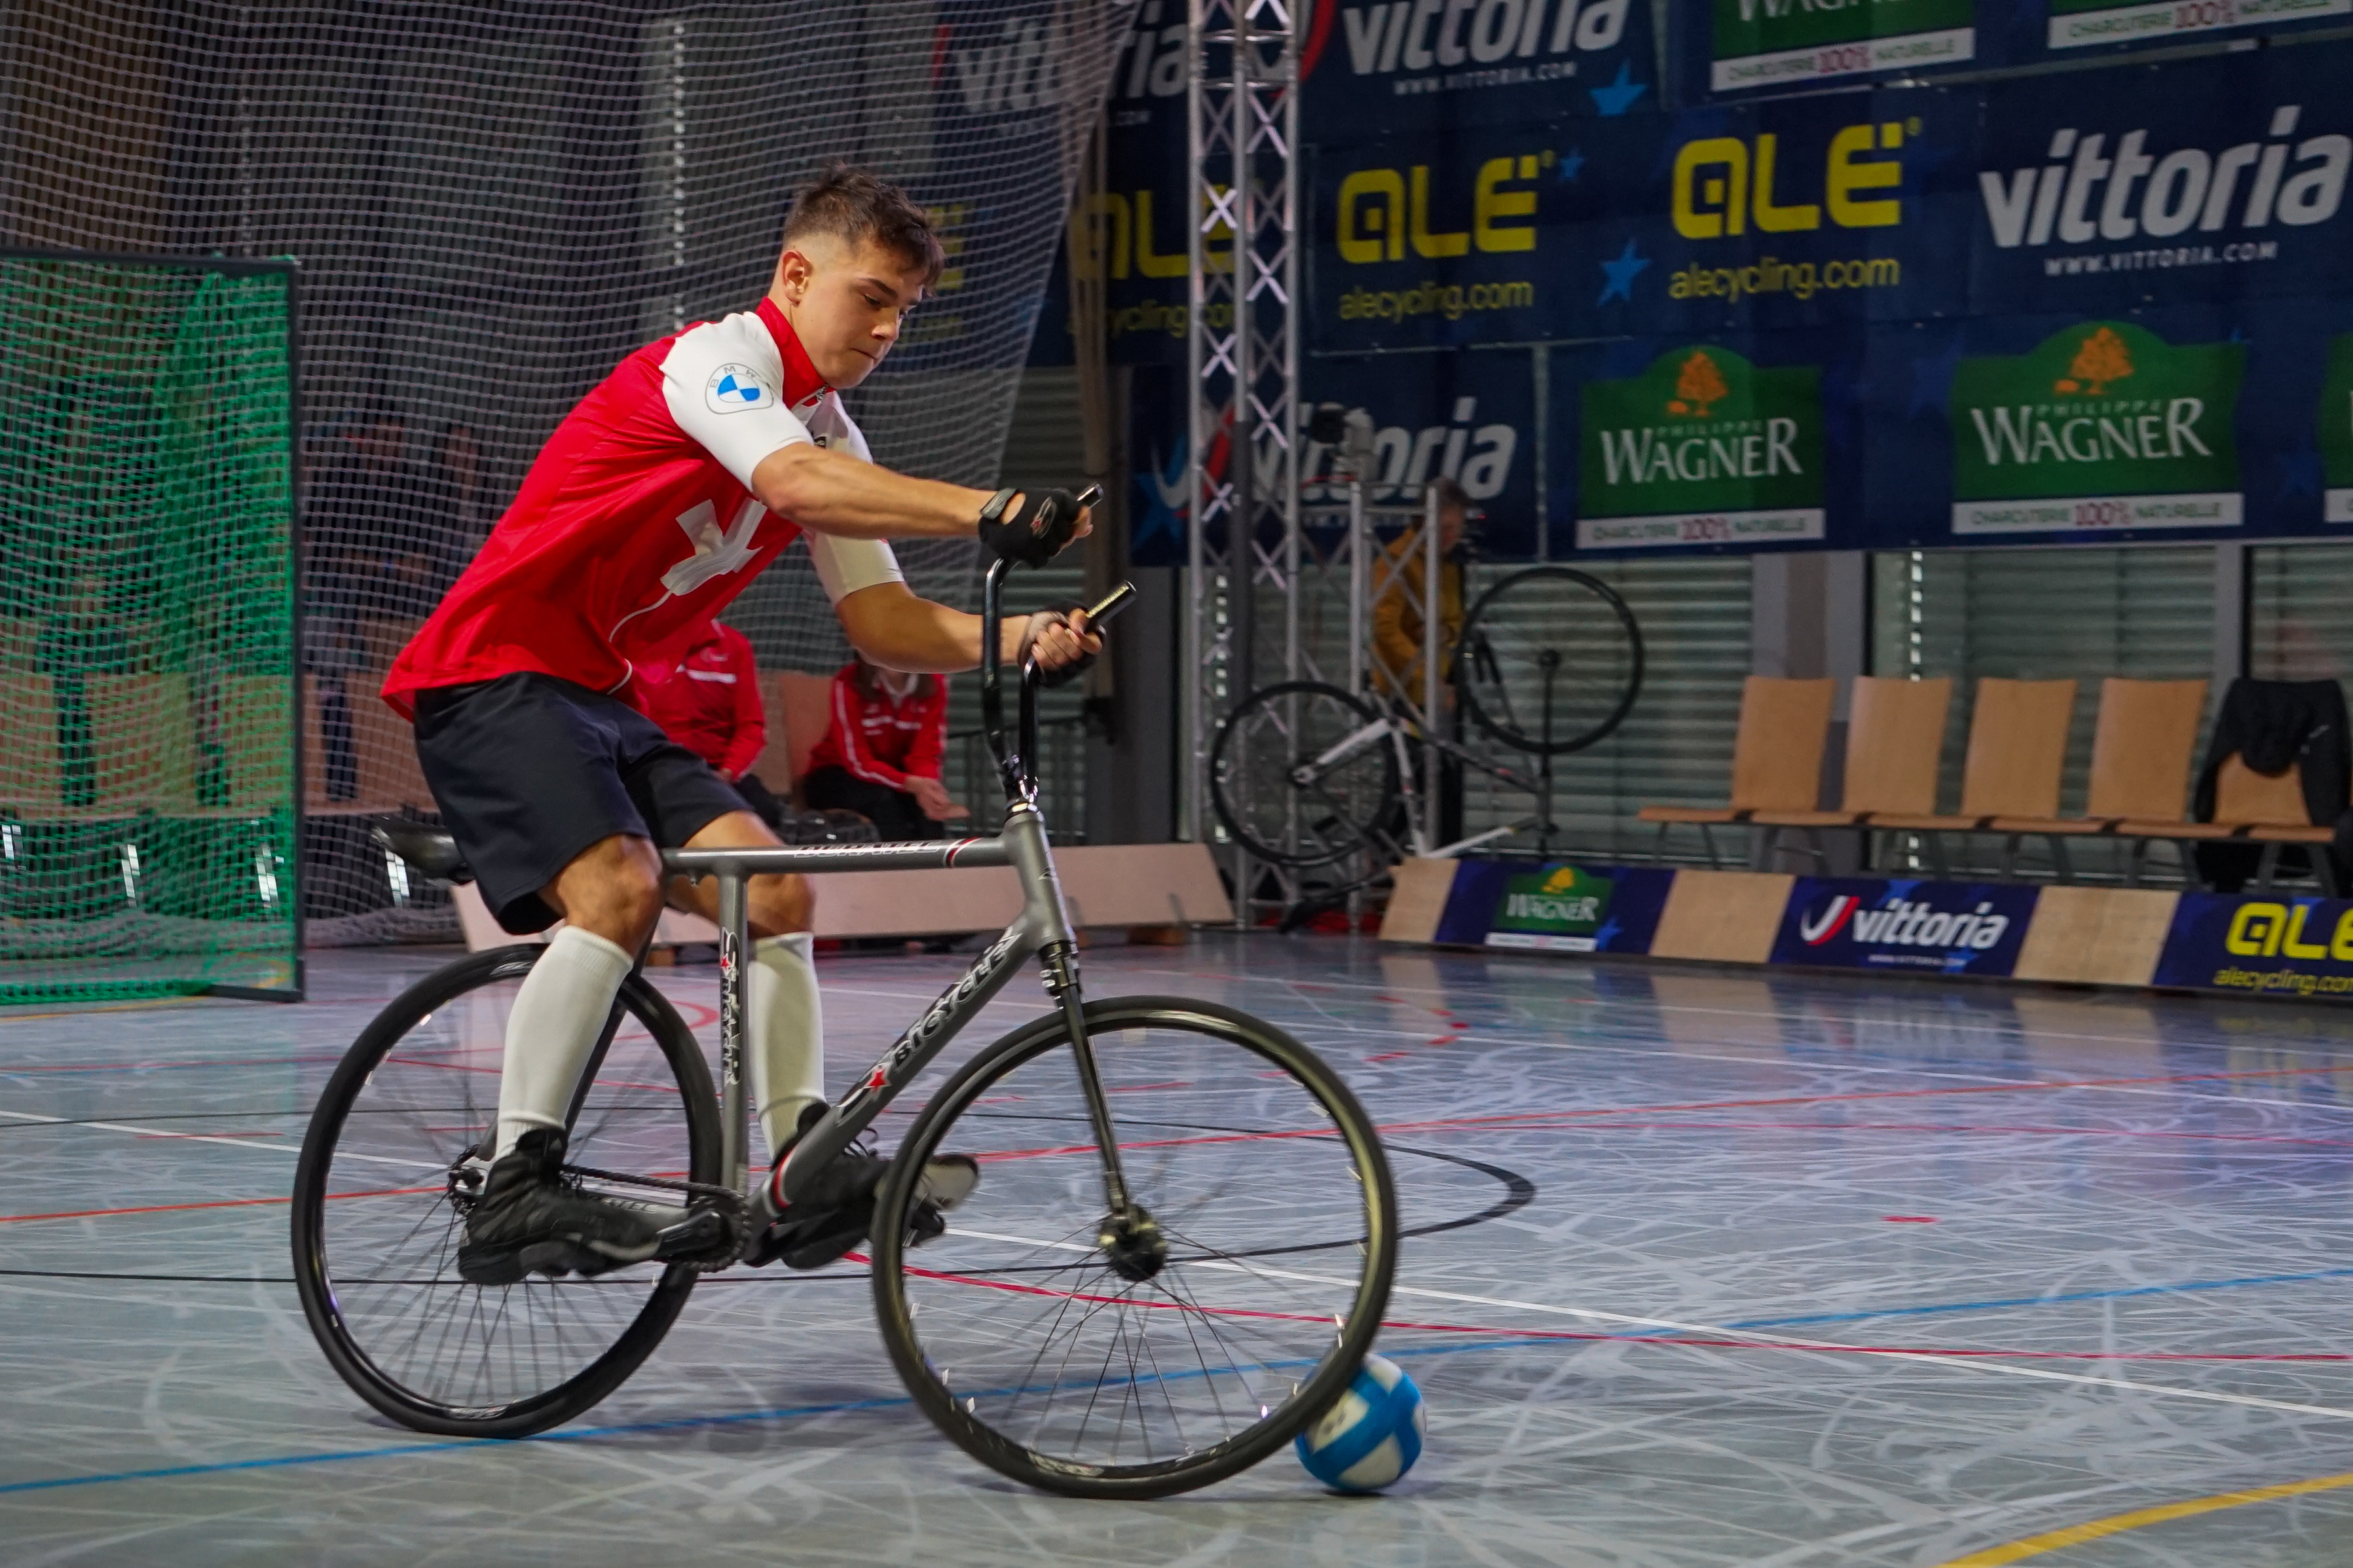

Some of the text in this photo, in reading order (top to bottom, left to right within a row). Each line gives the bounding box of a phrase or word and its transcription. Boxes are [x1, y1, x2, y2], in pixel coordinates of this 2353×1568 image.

[1978, 105, 2353, 248] vittoria
[1339, 281, 1534, 324] alecycling.com
[1669, 257, 1901, 303] alecycling.com
[1600, 417, 1803, 485] WAGNER
[1971, 397, 2214, 465] WAGNER
[1852, 897, 2009, 949] vittoria
